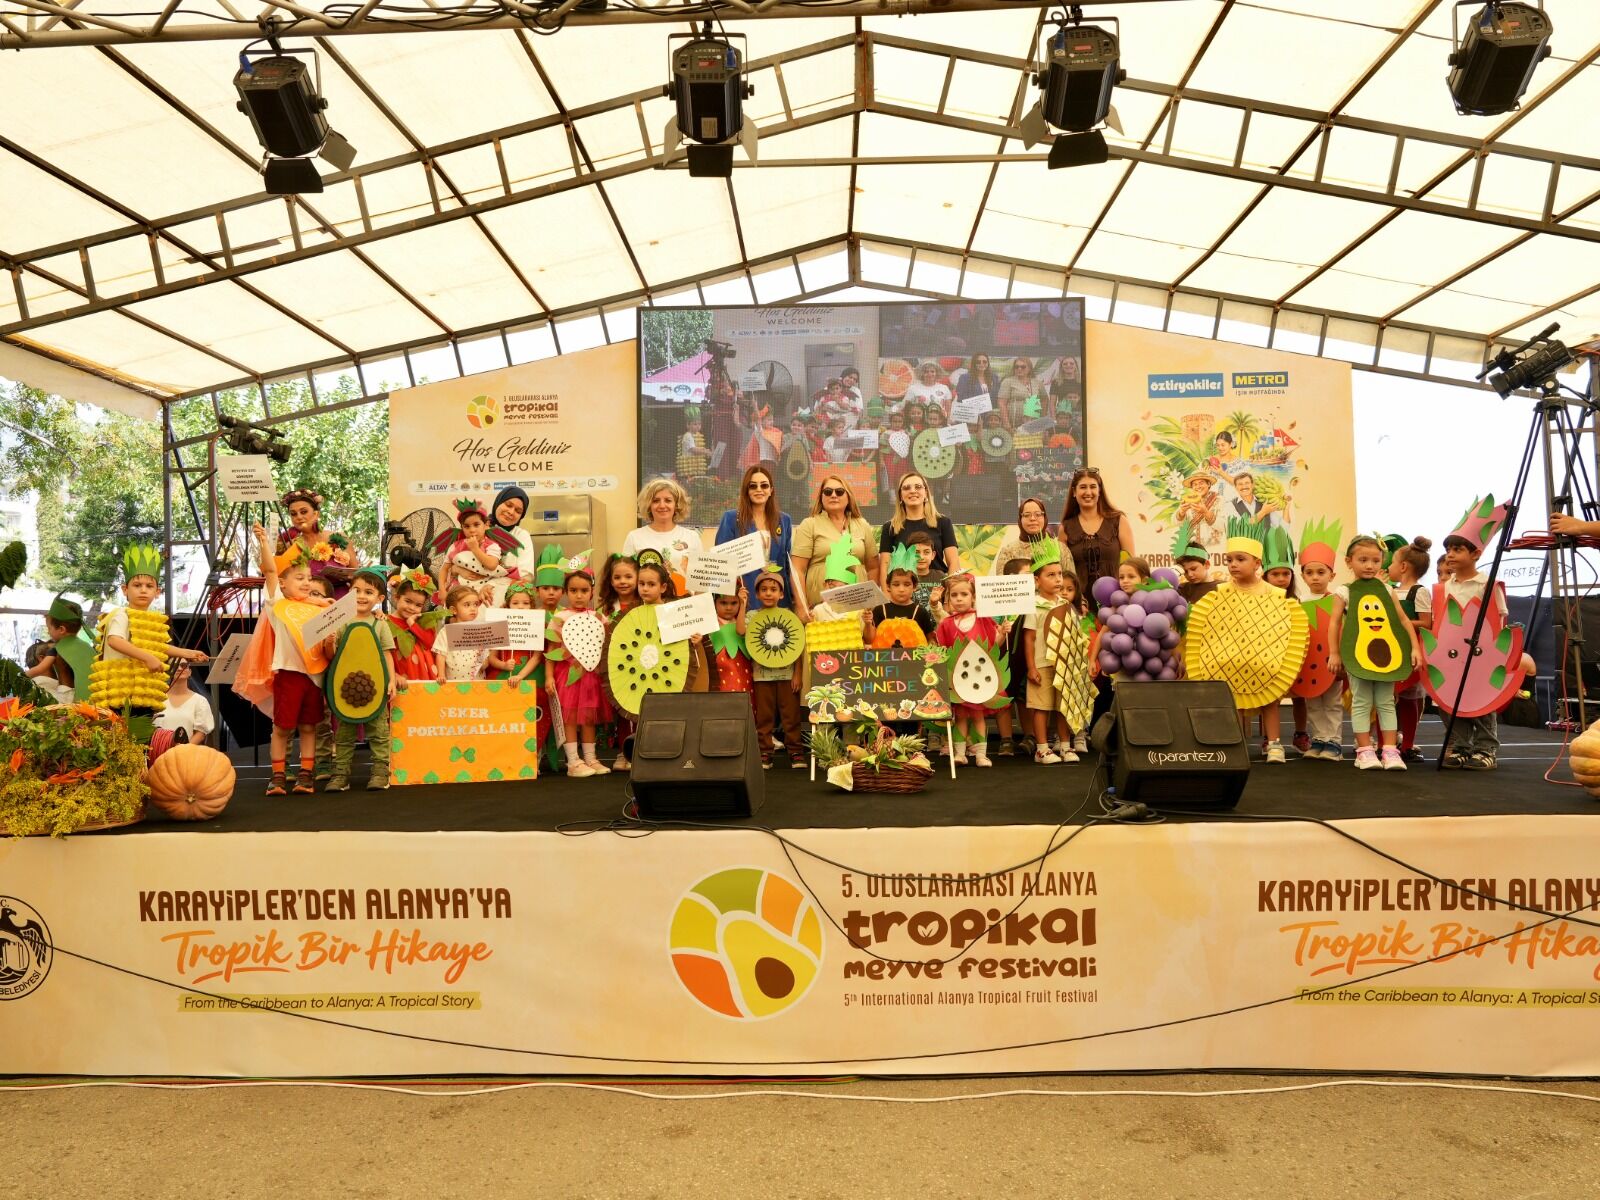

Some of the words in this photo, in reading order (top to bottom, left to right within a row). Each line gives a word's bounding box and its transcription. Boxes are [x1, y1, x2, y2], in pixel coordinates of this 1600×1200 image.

[1151, 379, 1222, 393] öztiryakiler
[1235, 375, 1286, 385] METRO
[504, 403, 558, 413] tropikal
[453, 438, 495, 461] Hoş
[496, 436, 572, 462] Geldiniz
[472, 461, 553, 473] WELCOME
[1503, 567, 1526, 578] FIRST
[838, 651, 922, 665] YILDIZLAR
[848, 665, 900, 680] SINIFI
[842, 680, 918, 696] SAHNEDE
[407, 723, 526, 737] PORTAKALLARI
[841, 873, 860, 898] 5.
[866, 872, 1014, 898] ULUSLARARASI
[1020, 871, 1098, 897] ALANYA
[1508, 878, 1600, 912] ALANY
[365, 887, 512, 920] ALANYA'YA
[842, 907, 1097, 949] tropikal
[160, 928, 293, 984] Tropik
[295, 931, 361, 970] Bir
[364, 928, 493, 985] Hikaye
[1279, 919, 1425, 976] Tropik
[1426, 922, 1500, 964] Bir
[1503, 920, 1600, 982] Hika
[843, 958, 946, 980] meyve
[958, 956, 1097, 980] festivali
[184, 996, 215, 1009] From
[218, 995, 238, 1009] the
[241, 996, 307, 1009] Caribbean
[311, 997, 324, 1009] to
[326, 996, 374, 1010] Alanya:
[376, 995, 386, 1007] A
[389, 994, 439, 1010] Tropical
[441, 994, 474, 1009] Story
[861, 991, 934, 1006] International
[937, 991, 975, 1006] Alanya
[978, 990, 1022, 1006] Tropical
[1026, 989, 1052, 1004] Fruit
[1056, 989, 1098, 1003] Festival
[1300, 989, 1335, 1001] From
[1339, 989, 1361, 1001] the
[1364, 989, 1439, 1002] Caribbean
[1442, 990, 1457, 1002] to
[1459, 990, 1514, 1006] Alanya:
[1517, 992, 1529, 1004] A
[1532, 991, 1586, 1007] Tropical
